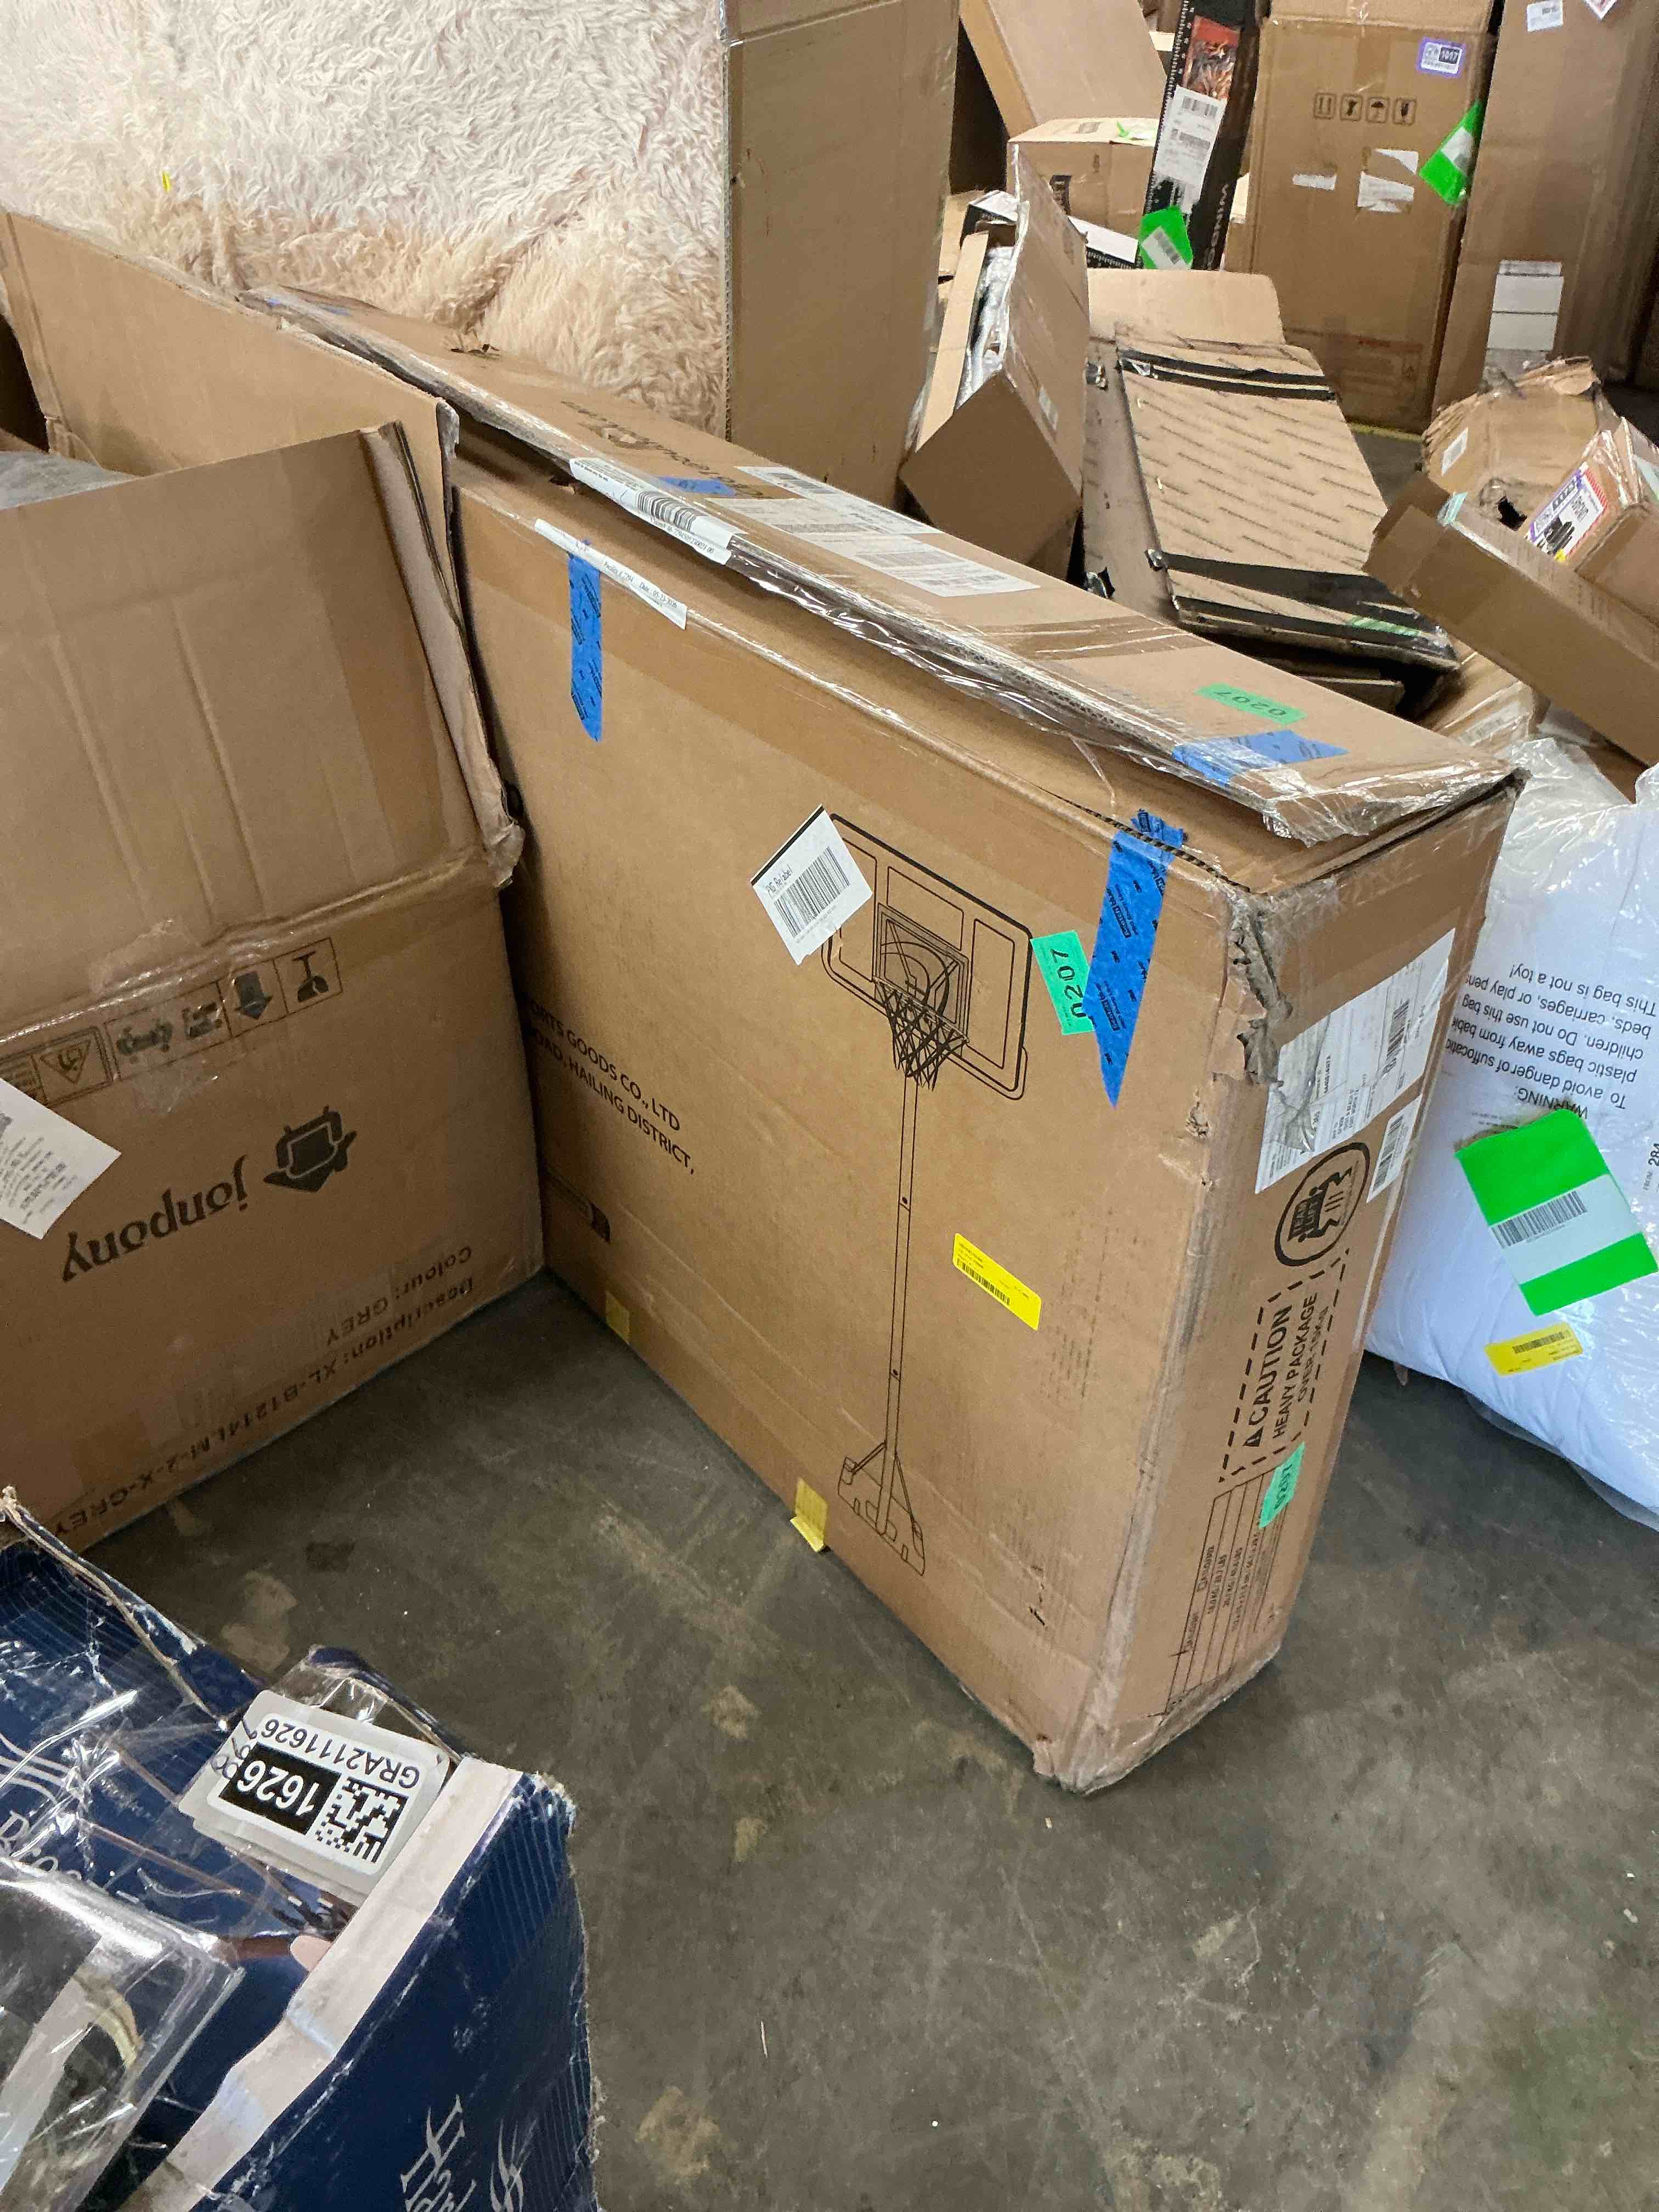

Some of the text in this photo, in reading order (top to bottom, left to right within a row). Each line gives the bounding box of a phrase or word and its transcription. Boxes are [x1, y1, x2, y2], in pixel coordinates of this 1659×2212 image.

[1489, 980, 1517, 1000] play
[1509, 963, 1657, 1018] This bag is not a toy!
[1517, 991, 1532, 1006] or
[1537, 995, 1606, 1025] carriages,
[1461, 993, 1644, 1060] children. Do not use this bag
[1479, 1026, 1508, 1045] from
[1611, 1017, 1652, 1041] beds,
[1509, 1035, 1545, 1057] away
[1496, 1059, 1510, 1074] of
[1548, 1050, 1585, 1073] bags
[1587, 1060, 1638, 1085] plastic
[566, 1029, 618, 1081] GOODS
[652, 1098, 680, 1131] LTD
[1511, 1065, 1561, 1091] danger
[1562, 1080, 1604, 1100] avoid
[1611, 1092, 1626, 1110] To
[569, 1056, 624, 1114] HAILING
[628, 1105, 694, 1175] DISTRICT,
[61, 1154, 249, 1283] jonpony
[326, 1244, 473, 1345] Colour: GREY
[1248, 1304, 1293, 1426] CAUTION
[1272, 1293, 1317, 1439] HEAVY PACKAGE
[260, 1718, 421, 1789] GRA2111626
[236, 1759, 320, 1816] 1626
